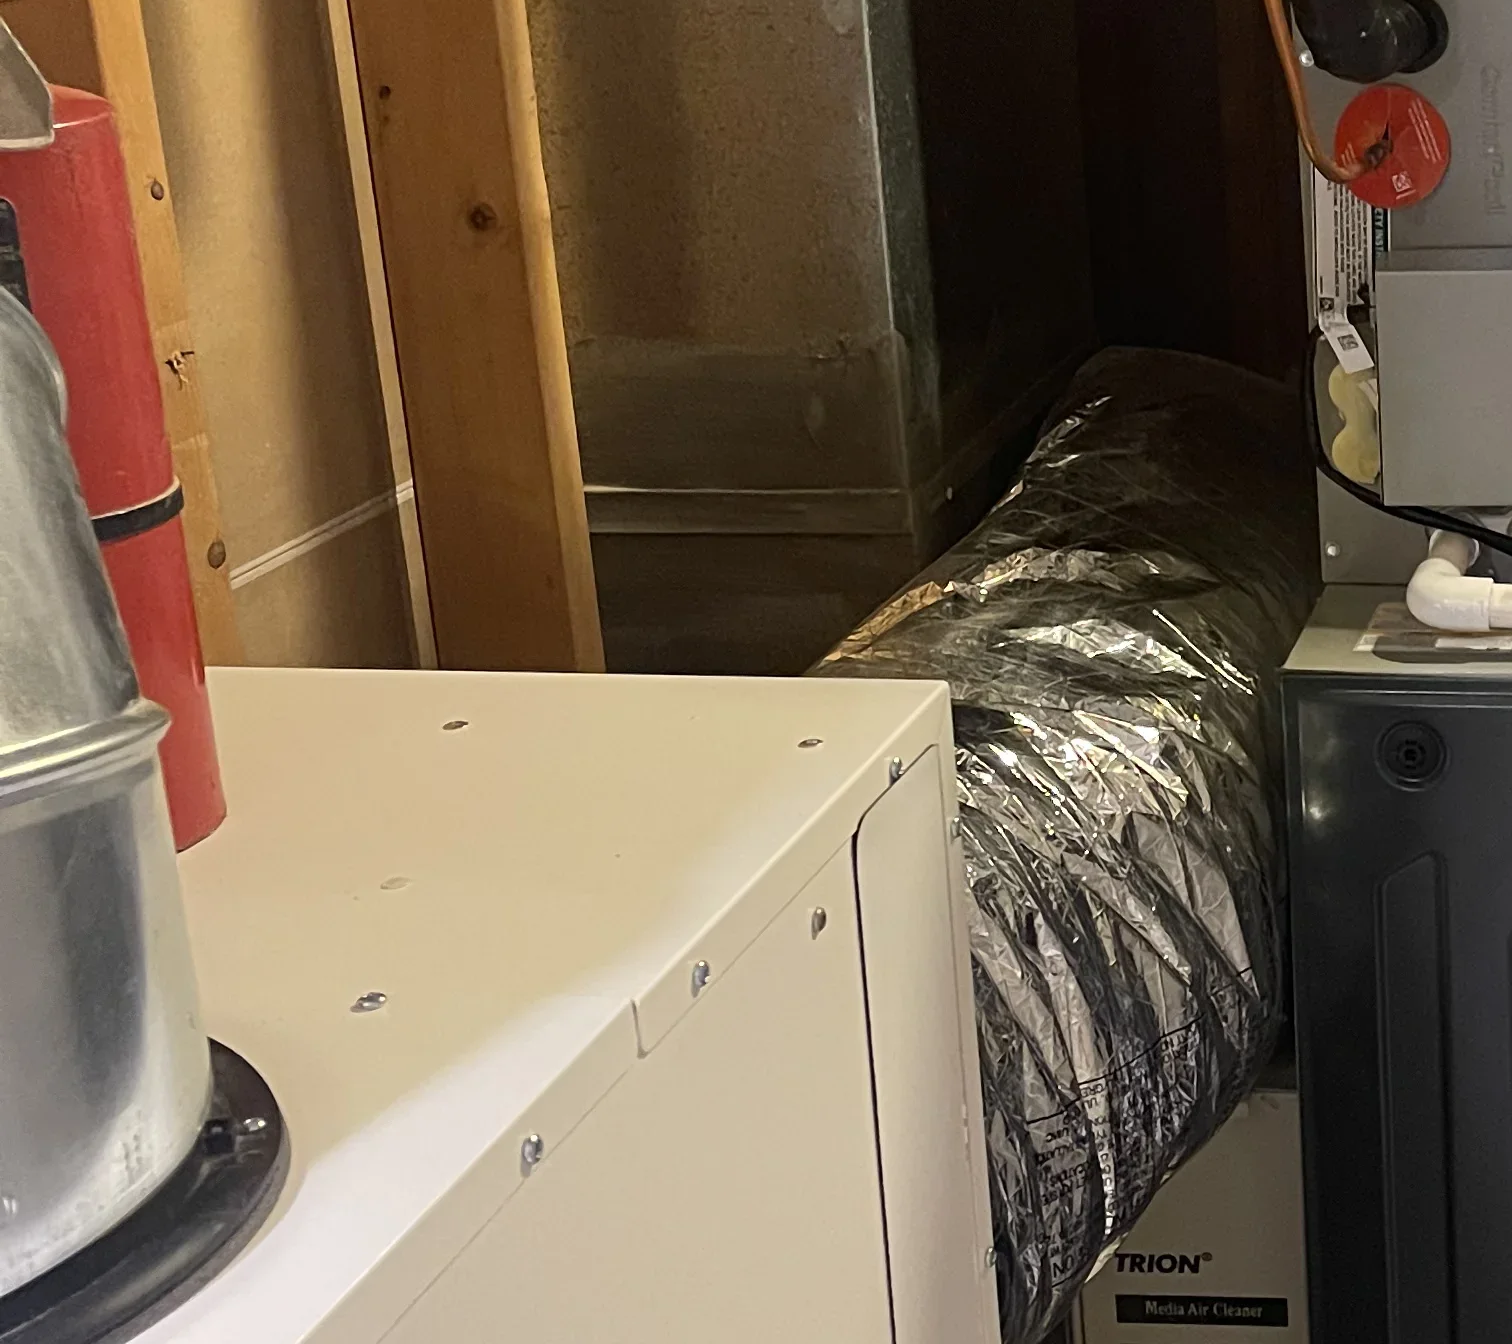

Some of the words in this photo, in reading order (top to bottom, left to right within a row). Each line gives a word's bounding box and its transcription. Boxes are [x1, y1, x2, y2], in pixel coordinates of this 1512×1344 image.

[1144, 1301, 1184, 1316] Media
[1188, 1302, 1209, 1317] Air
[1213, 1303, 1263, 1318] Cleaner
